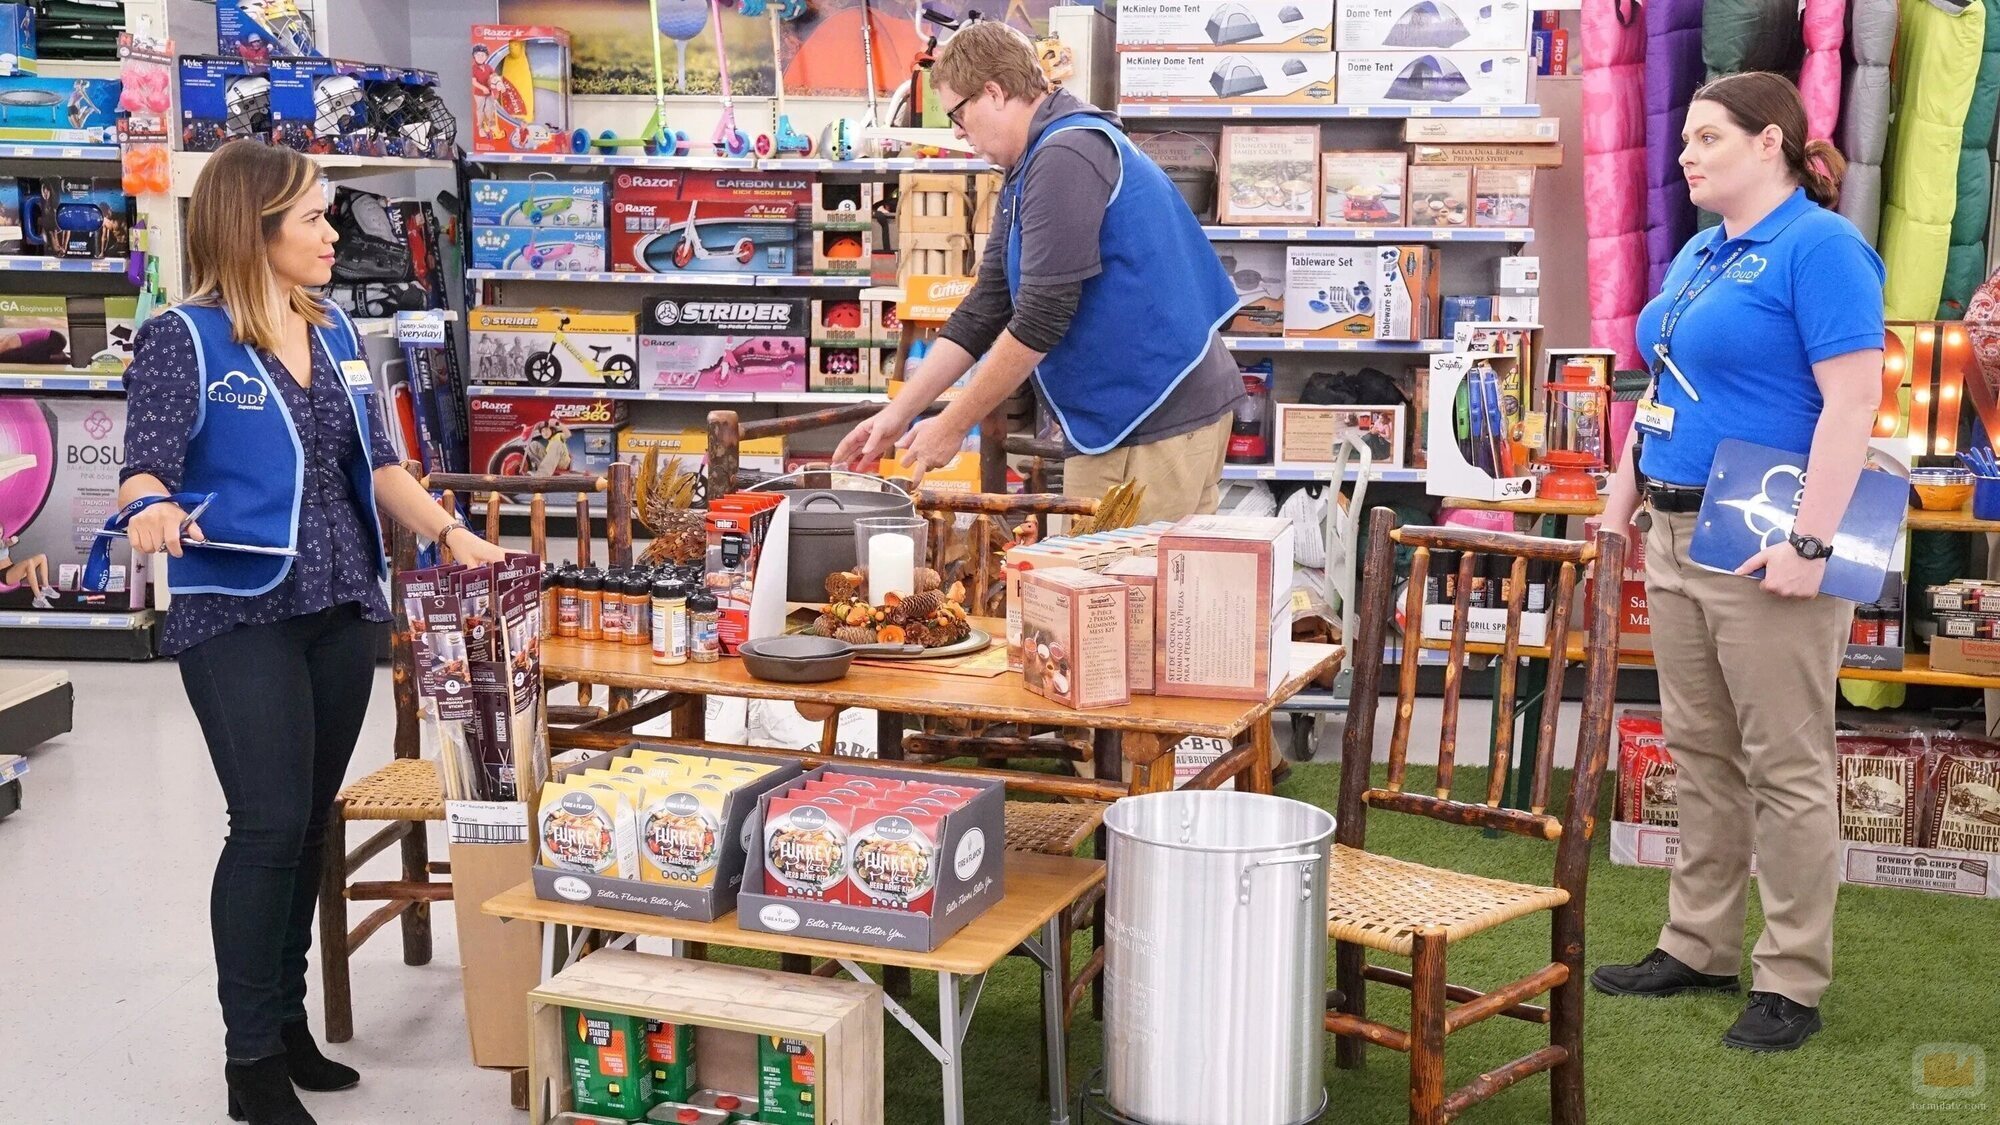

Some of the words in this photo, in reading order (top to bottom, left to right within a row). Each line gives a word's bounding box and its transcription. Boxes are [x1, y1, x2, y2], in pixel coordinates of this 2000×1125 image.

[1122, 5, 1157, 14] McKinley
[1159, 5, 1182, 13] Dome
[1184, 5, 1200, 13] Tent
[1346, 9, 1371, 18] Dome
[1374, 9, 1392, 18] Tent
[483, 28, 512, 37] Razor
[1554, 39, 1564, 62] PRO
[183, 59, 203, 69] Mylec
[272, 60, 292, 70] Mylec
[1126, 57, 1161, 66] McKinley
[1163, 57, 1186, 65] Dome
[1188, 57, 1204, 65] Tent
[1347, 62, 1372, 72] Dome
[1375, 62, 1393, 72] Tent
[631, 176, 677, 187] Razor
[716, 179, 775, 188] CARBON
[778, 179, 807, 188] LUX
[572, 186, 600, 195] Scribble
[625, 204, 658, 213] Razor
[764, 206, 788, 214] LUX
[827, 212, 856, 222] nutcase
[574, 231, 602, 241] Scribble
[828, 259, 857, 269] nutcase
[1291, 257, 1336, 267] Tableware
[1338, 257, 1353, 267] Set
[929, 281, 970, 300] Cutter
[1383, 284, 1392, 296] Set
[0, 301, 19, 312] GA
[20, 305, 53, 313] Beginners
[681, 302, 789, 322] STRIDER
[491, 317, 539, 326] STRIDER
[1382, 297, 1391, 337] Tableware
[416, 322, 440, 330] Savings
[400, 329, 443, 340] Everyday!
[826, 329, 855, 339] nutcase
[824, 376, 854, 386] nutcase
[207, 390, 266, 405] CLOUD9
[481, 401, 513, 410] Razor
[555, 403, 590, 412] FLASH
[580, 411, 611, 422] 360
[1646, 414, 1661, 426] DINA
[67, 445, 126, 465] BOSU
[498, 570, 523, 580] HERSHEY'S
[405, 582, 435, 592] HERSHEY'S
[465, 580, 489, 591] HERSHEY'S
[428, 613, 457, 623] HERSHEY'S
[1170, 610, 1177, 624] DE
[1086, 621, 1118, 629] ALUMINUM
[1470, 621, 1491, 631] GRILL
[1169, 625, 1177, 655] COCINA
[1177, 629, 1184, 641] DE
[1184, 616, 1192, 655] PERSONAS
[1168, 658, 1176, 669] DE
[1175, 641, 1183, 682] ALUMINIO
[1183, 663, 1191, 682] PARA
[449, 680, 456, 689] 4
[495, 711, 507, 743] HERSHEY'S
[1845, 757, 1904, 786] COWBOY
[1642, 808, 1662, 819] 100%
[1842, 815, 1864, 826] 100%
[1866, 816, 1904, 828] NATURAL
[1941, 819, 1961, 831] 100%
[552, 828, 603, 847] TURKEY
[654, 827, 705, 847] TURKEY
[1843, 825, 1902, 844] MESQUITE
[1940, 830, 1999, 852] MESQUITE
[559, 843, 599, 859] Perfect
[660, 843, 701, 859] Perfect
[780, 842, 832, 860] TURKEY
[864, 852, 919, 870] TURKEY
[1876, 855, 1913, 866] COWBOY
[1929, 860, 1958, 869] CHIPS
[784, 859, 828, 875] Perfect
[1875, 864, 1912, 877] MESQUITE
[1913, 867, 1935, 879] WOOD
[1936, 869, 1957, 881] CHIPS
[784, 871, 798, 879] HERB
[869, 869, 913, 885] Perfect
[869, 882, 883, 890] HERB
[884, 883, 900, 891] BRINE
[1875, 875, 1898, 883] ASTILLAS
[1905, 878, 1925, 887] MADERA
[597, 889, 620, 900] Better
[650, 896, 674, 907] Better
[674, 899, 692, 911] You.
[806, 917, 830, 929] Better
[862, 925, 888, 936] Better
[888, 928, 907, 941] You.
[587, 1019, 610, 1030] SMARTER
[588, 1028, 610, 1038] STARTER
[592, 1037, 607, 1046] FLUID
[786, 1044, 801, 1054] FLUID
